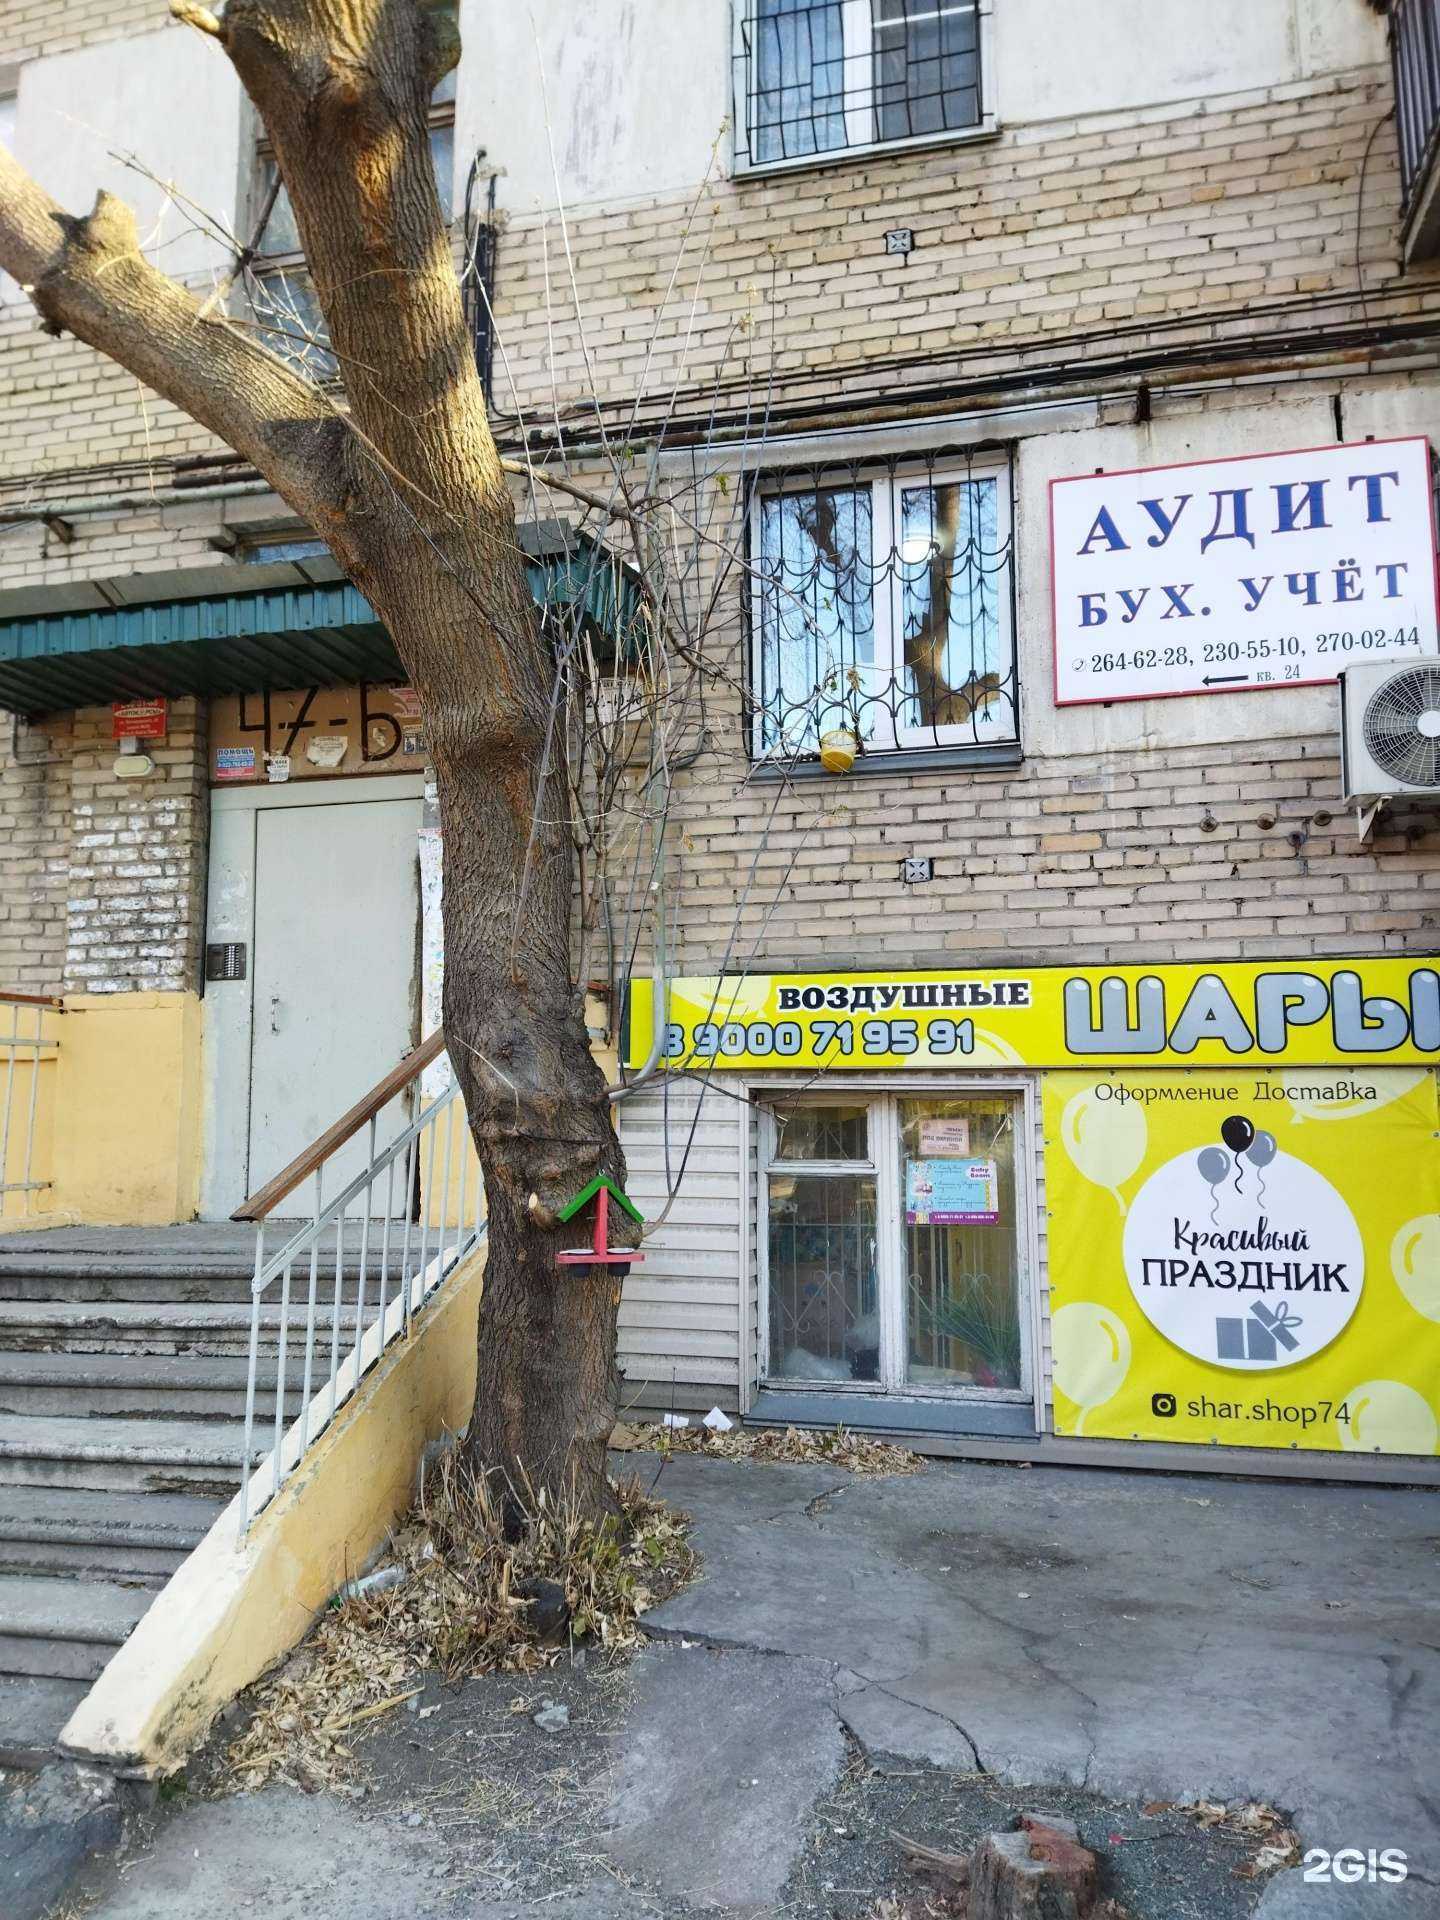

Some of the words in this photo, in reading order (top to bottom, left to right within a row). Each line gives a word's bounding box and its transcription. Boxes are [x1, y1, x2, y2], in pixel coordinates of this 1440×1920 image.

[1077, 471, 1399, 555] АУДИТ
[1078, 584, 1211, 628] БУХ.
[1238, 558, 1408, 612] УЧЁТ
[1091, 646, 1194, 673] 264-62-28,
[1203, 637, 1306, 663] 230-55-10,
[1316, 626, 1420, 653] 270-02-44
[1284, 665, 1300, 680] 24
[779, 982, 1029, 1013] ВОЗДУШНЫЕ
[1063, 968, 1440, 1054] ШАРЫ
[693, 1021, 802, 1057] 9000
[811, 1020, 853, 1056] 71
[862, 1018, 919, 1055] 95
[927, 1018, 975, 1055] 91
[1095, 1083, 1239, 1106] Оформление
[1174, 1216, 1310, 1256] Красивый
[1142, 1258, 1350, 1293] ПРАЗДНИК
[1188, 1396, 1351, 1429] shar.shop74
